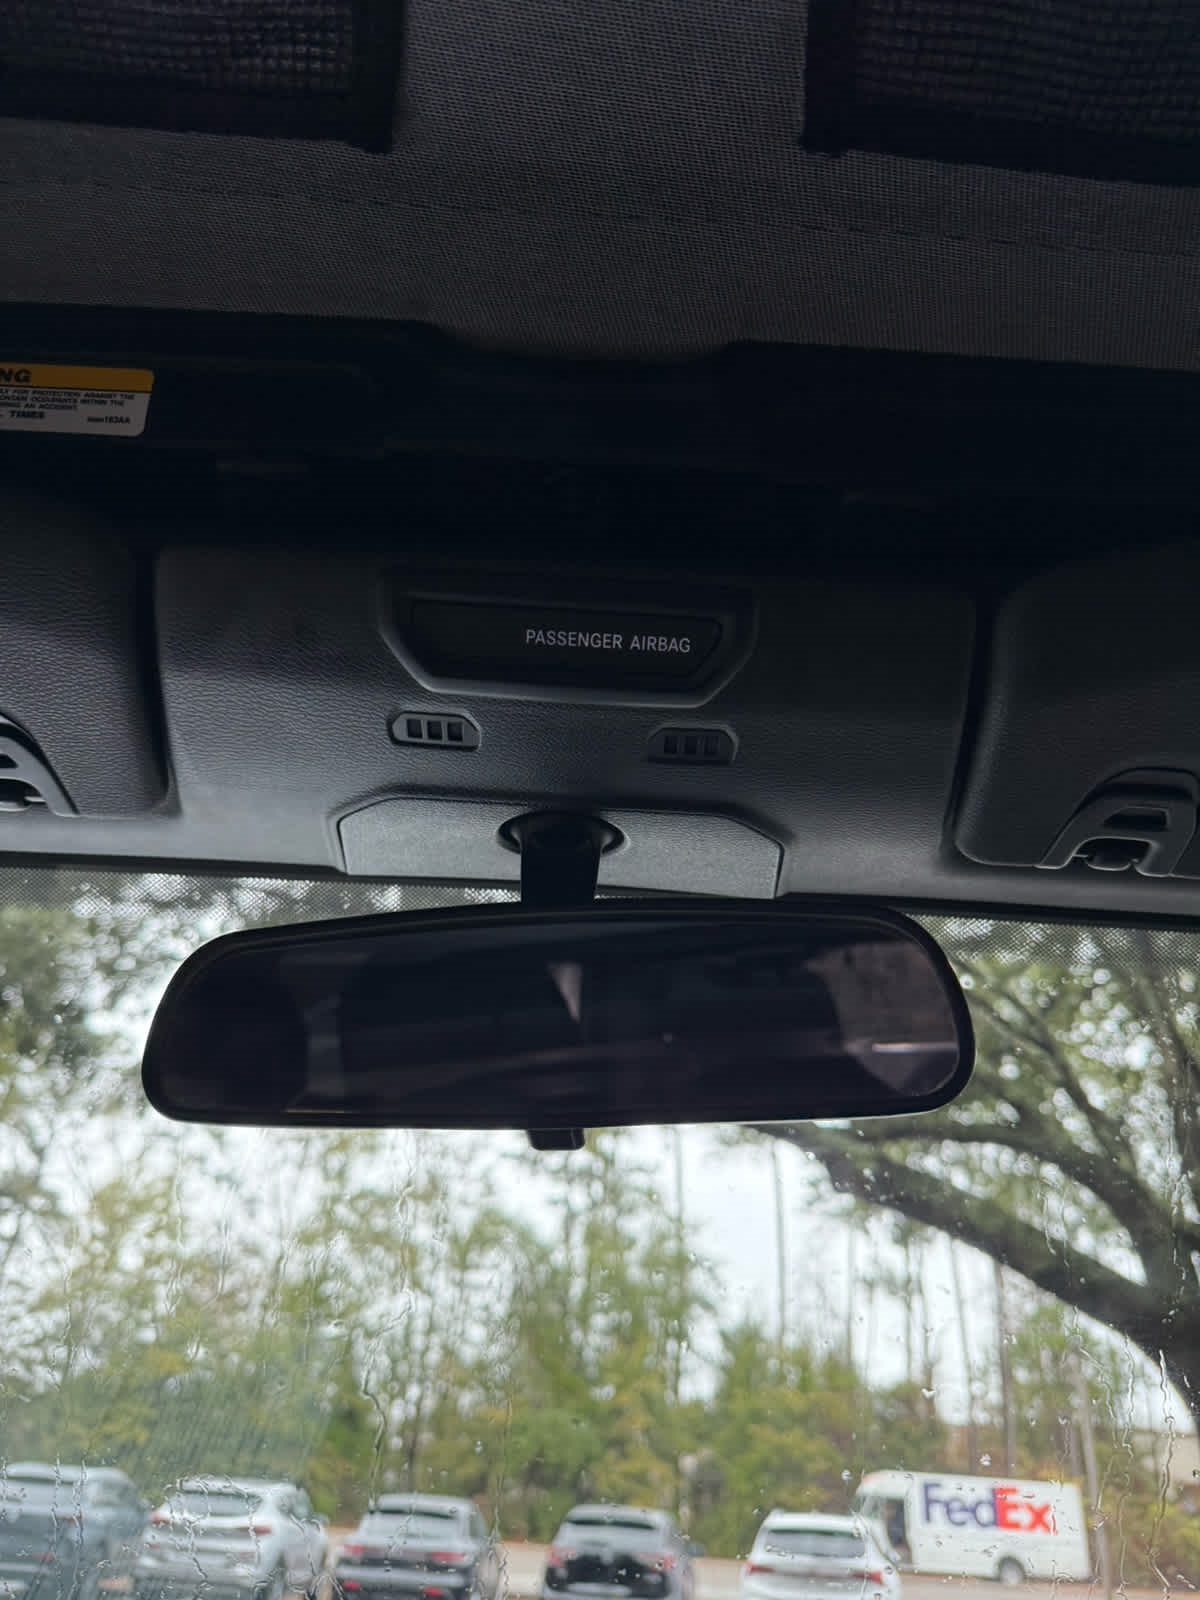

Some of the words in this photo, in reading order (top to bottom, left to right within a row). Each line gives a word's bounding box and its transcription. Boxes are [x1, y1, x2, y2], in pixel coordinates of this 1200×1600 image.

[525, 629, 623, 649] PASSENGER
[629, 635, 691, 653] AIRBAG
[923, 1482, 1054, 1534] FedEx
